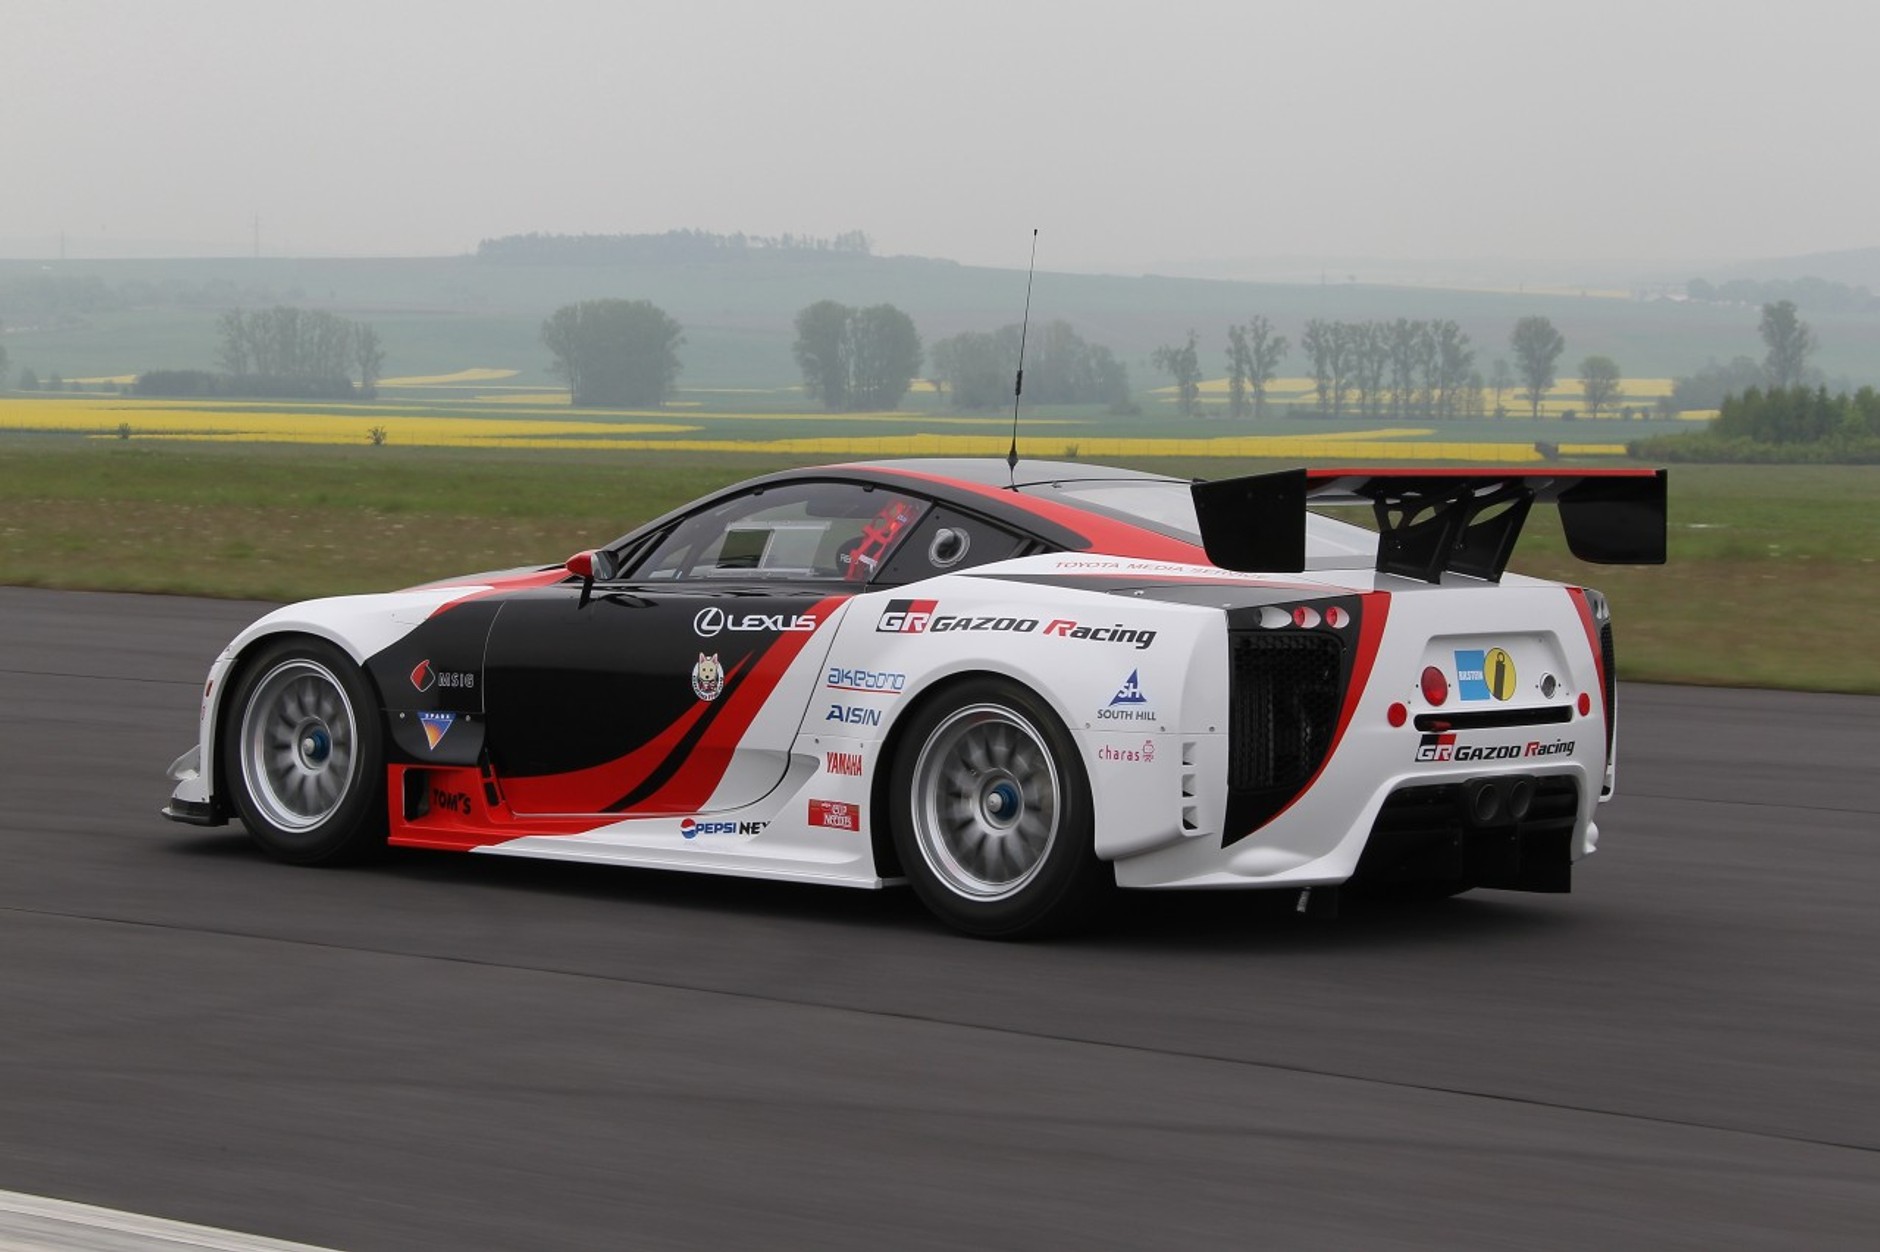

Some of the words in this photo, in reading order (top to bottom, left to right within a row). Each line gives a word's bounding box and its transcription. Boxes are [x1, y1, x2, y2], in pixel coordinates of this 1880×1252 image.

[1055, 561, 1121, 569] TOYOTA
[1127, 562, 1184, 572] MEDIA
[727, 615, 816, 631] LEXUS
[878, 611, 931, 632] GR
[930, 616, 1039, 632] GAZOO
[1043, 619, 1157, 650] Racing
[438, 672, 474, 688] MSIG
[828, 667, 906, 690] akebono
[825, 704, 882, 726] AISIN
[1097, 709, 1133, 720] SOUTH
[1135, 711, 1157, 721] HILL
[1098, 744, 1140, 761] charas
[1417, 744, 1452, 761] GR
[1454, 745, 1522, 761] GAZOO
[1524, 738, 1575, 757] Racing
[826, 751, 862, 776] YAMAHA
[433, 787, 472, 816] TOM'S
[696, 822, 737, 834] PEPSI
